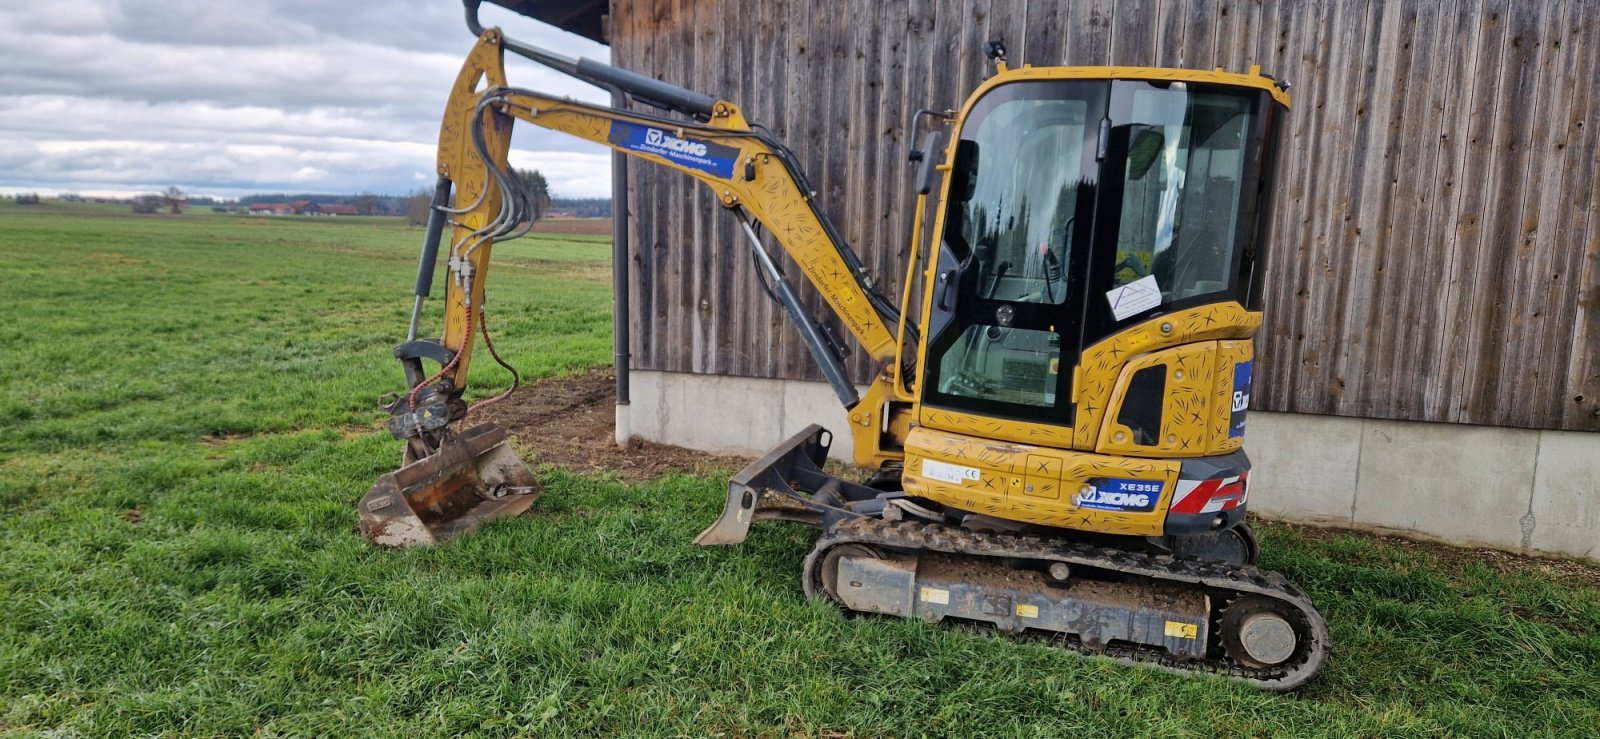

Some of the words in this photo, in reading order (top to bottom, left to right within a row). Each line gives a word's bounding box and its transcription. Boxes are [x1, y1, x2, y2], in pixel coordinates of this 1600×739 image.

[661, 135, 708, 157] XCMG
[965, 469, 976, 479] CE
[1120, 482, 1160, 492] XE35E
[1095, 490, 1150, 507] XCMG
